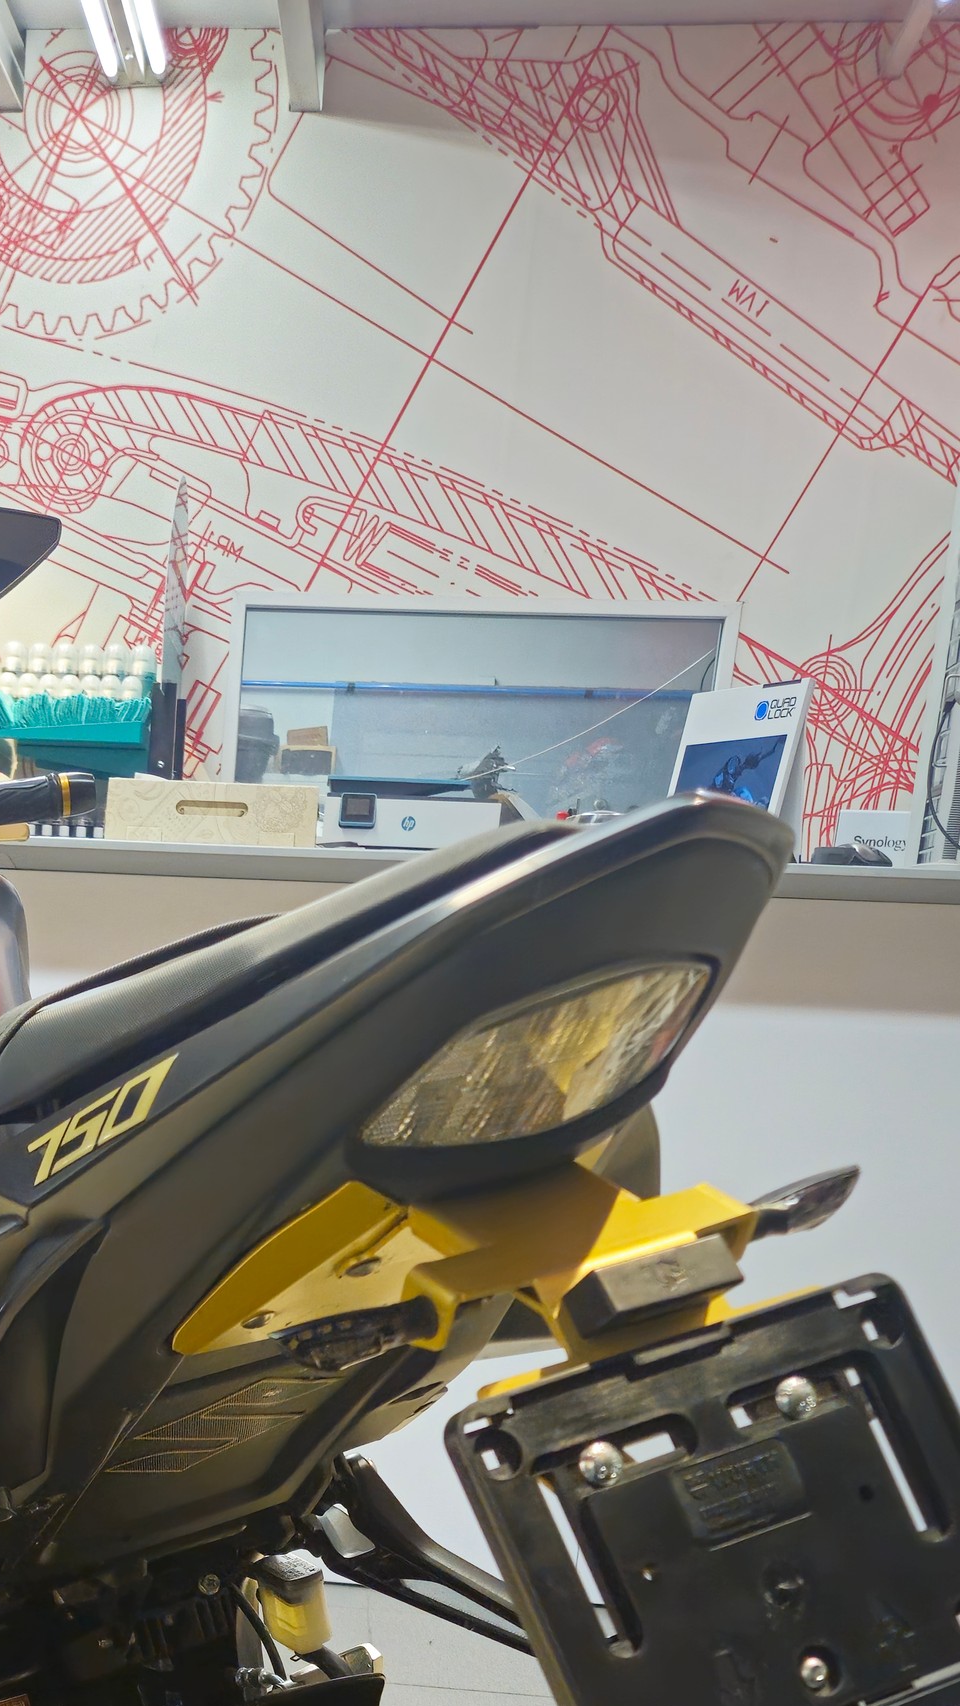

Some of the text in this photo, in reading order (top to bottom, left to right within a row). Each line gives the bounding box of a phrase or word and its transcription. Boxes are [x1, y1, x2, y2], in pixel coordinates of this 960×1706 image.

[769, 696, 797, 710] QUAD
[767, 706, 796, 720] LOCK
[401, 815, 416, 832] hp
[27, 1053, 179, 1187] 750
